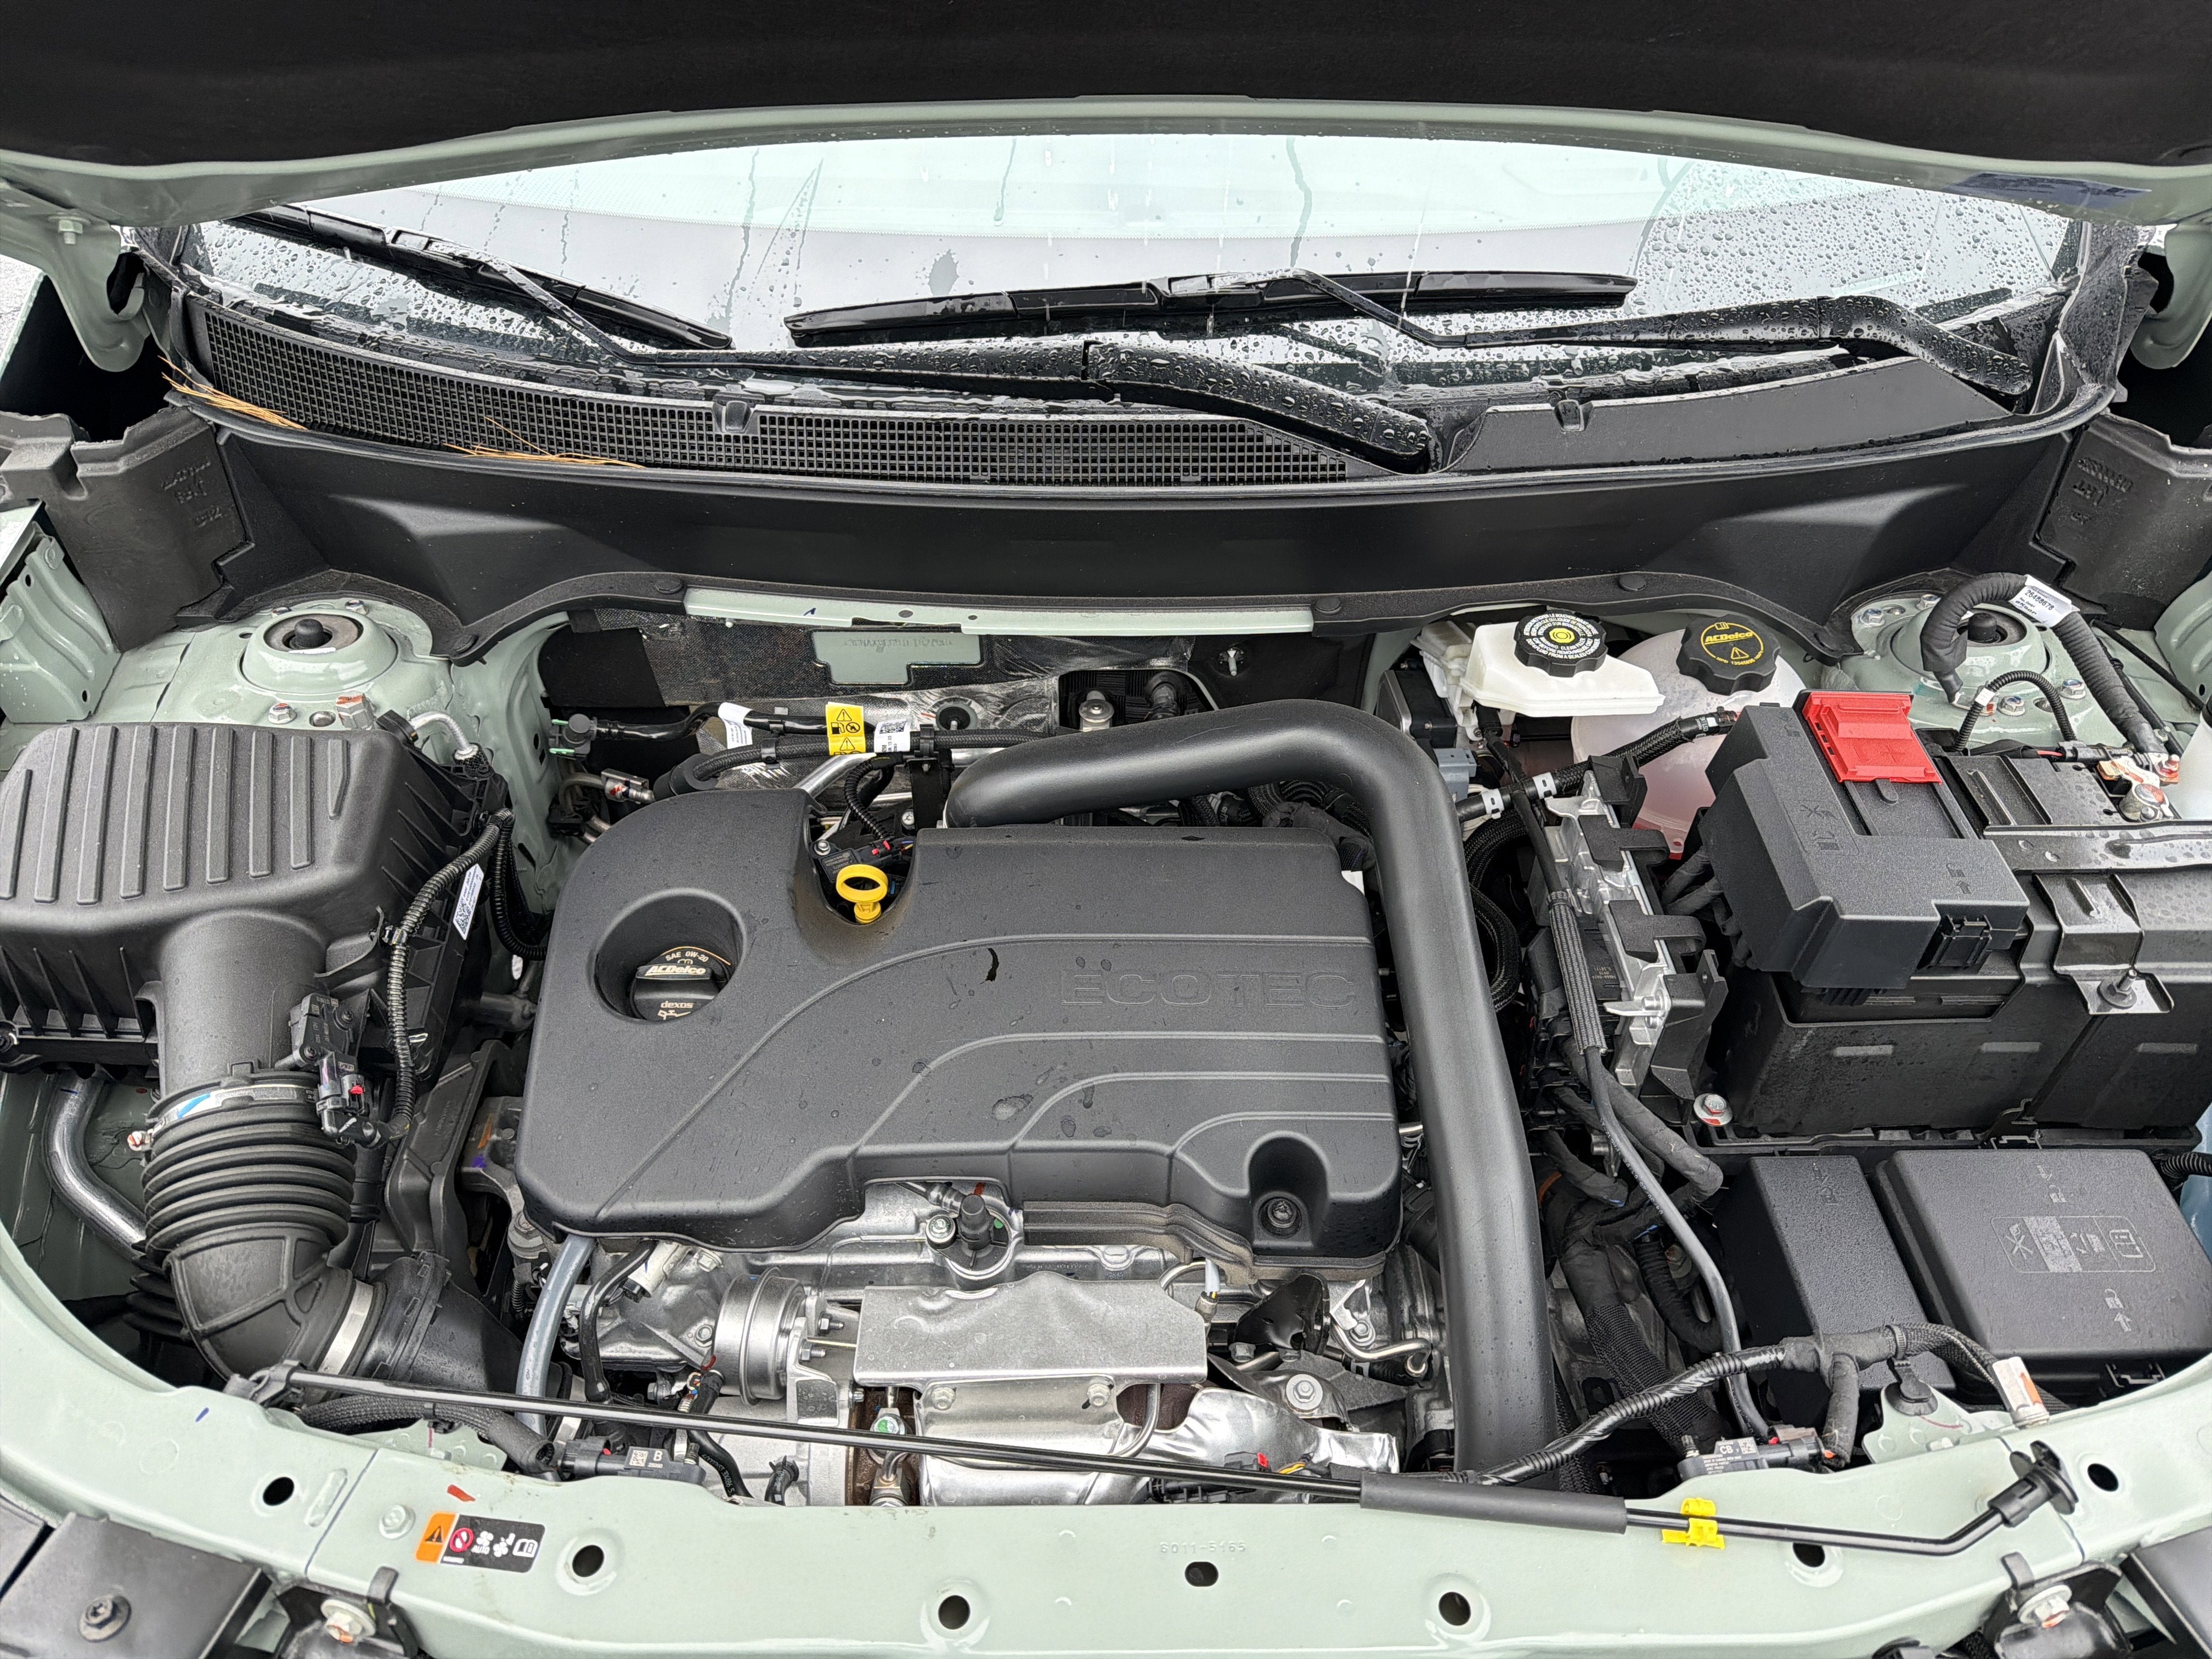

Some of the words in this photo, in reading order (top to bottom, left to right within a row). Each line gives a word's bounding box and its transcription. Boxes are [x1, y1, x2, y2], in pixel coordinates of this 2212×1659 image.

[1705, 632, 1754, 644] ACDelco
[665, 951, 681, 961] SAE
[685, 951, 709, 962] 0W-20
[645, 965, 706, 975] ACDelco
[1062, 969, 1356, 1008] ECOTEC
[1719, 1445, 1734, 1454] CB
[653, 1450, 663, 1462] B
[471, 1545, 490, 1555] AUTO
